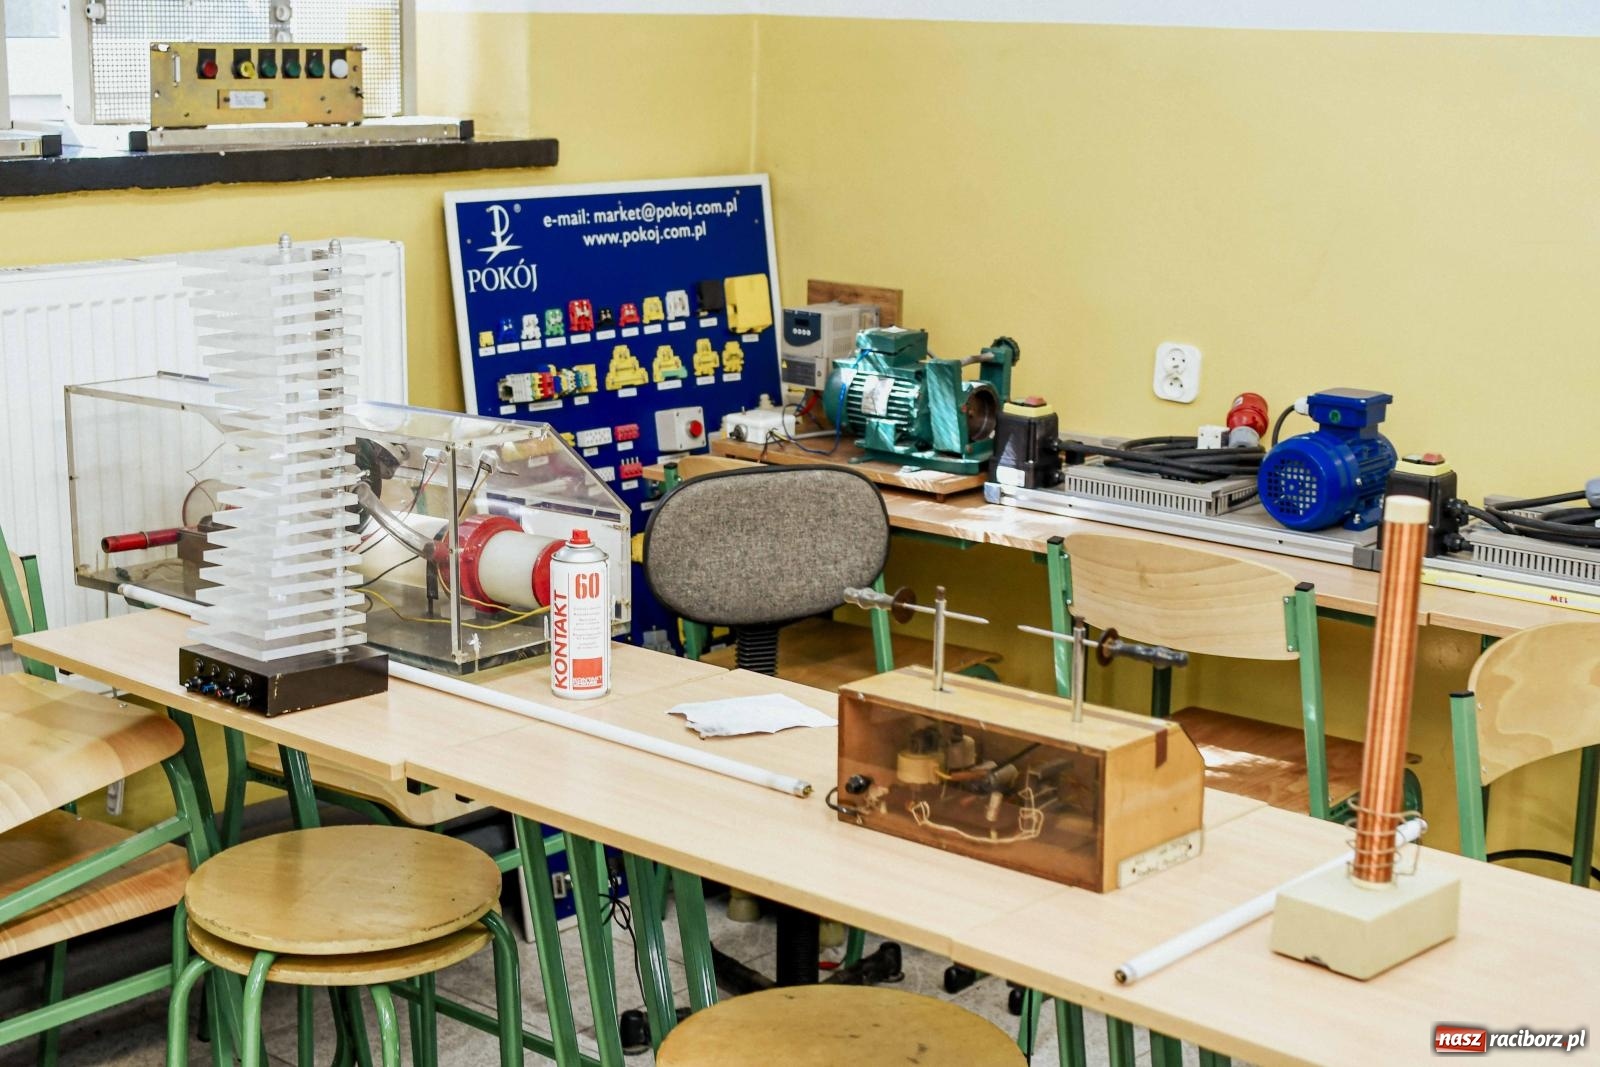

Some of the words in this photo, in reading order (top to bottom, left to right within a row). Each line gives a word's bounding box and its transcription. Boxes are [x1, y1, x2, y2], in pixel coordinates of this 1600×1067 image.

[543, 208, 590, 228] e-mail:
[593, 197, 738, 224] market@pokoj.com.pl
[582, 220, 707, 248] www.pokoj.com.pl
[466, 258, 538, 293] POKÓJ
[575, 572, 600, 600] 60
[554, 589, 568, 690] KONTAKT
